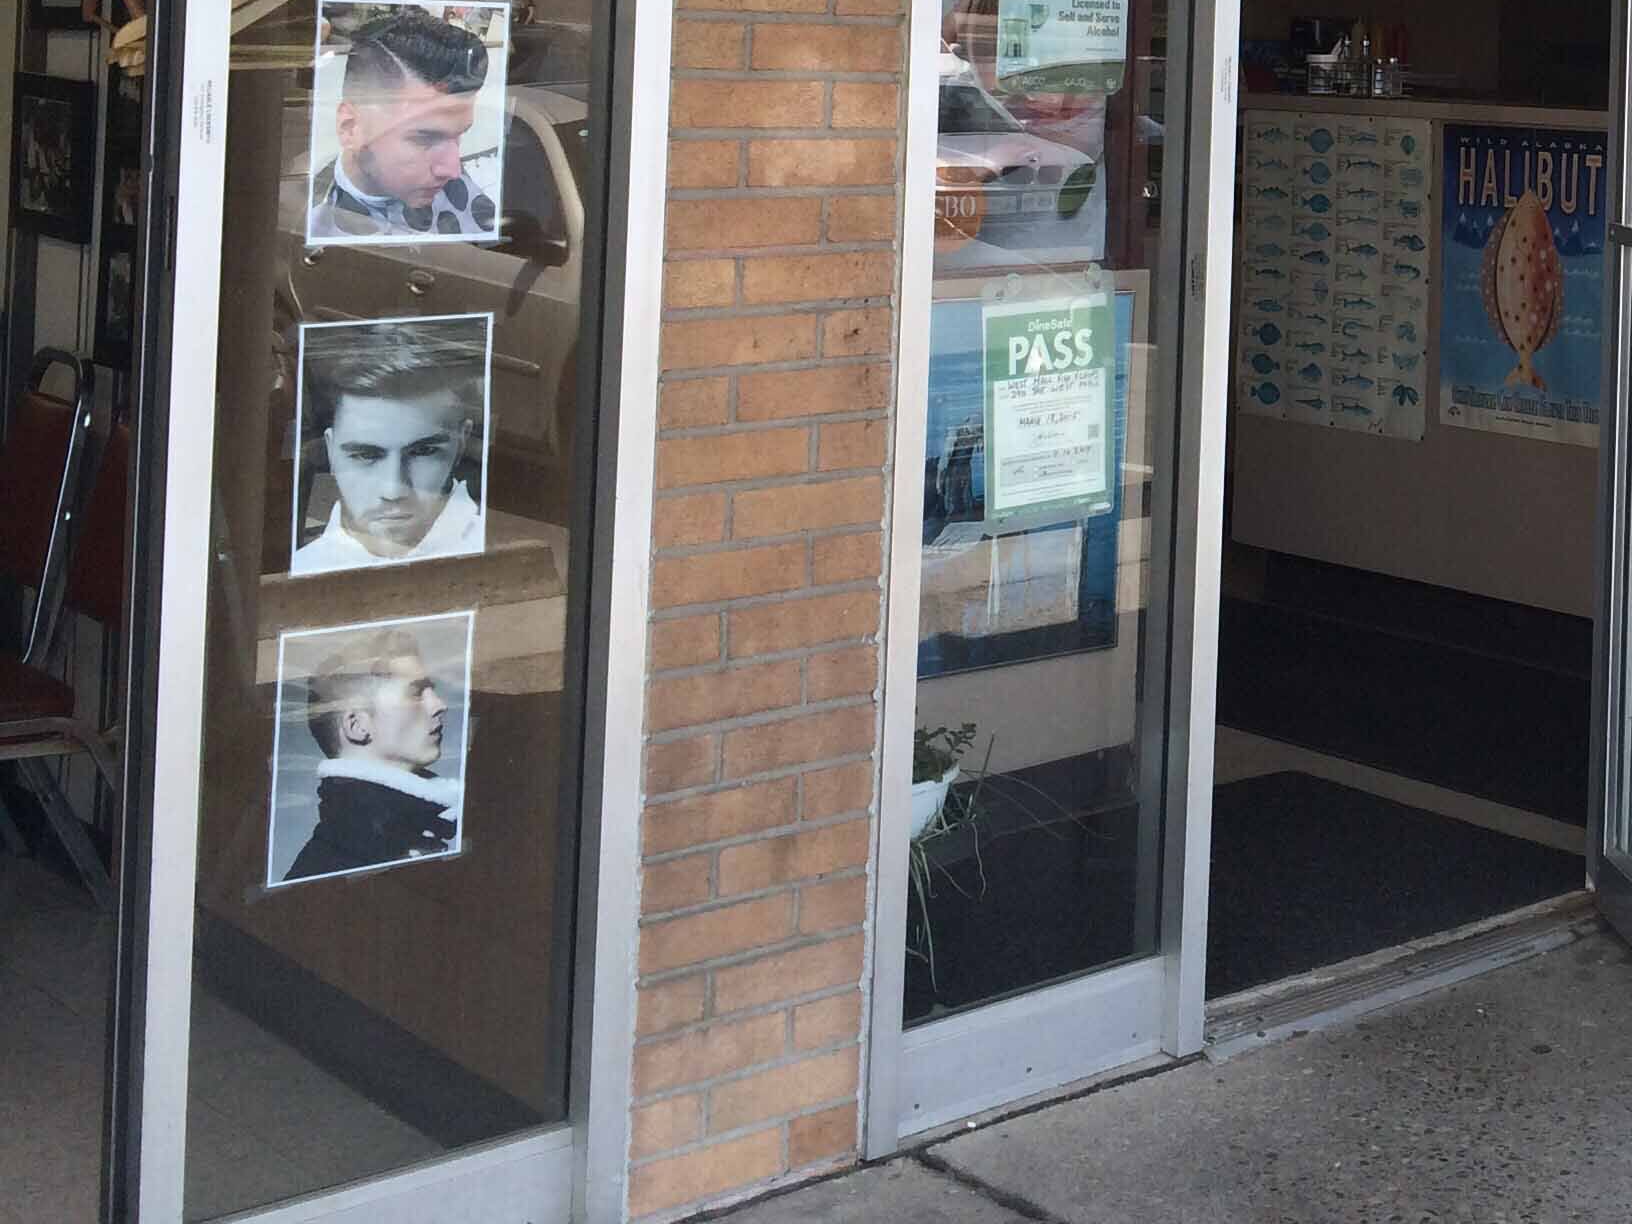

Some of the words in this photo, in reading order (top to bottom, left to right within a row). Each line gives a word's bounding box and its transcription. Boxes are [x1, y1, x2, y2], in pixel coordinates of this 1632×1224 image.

[1459, 136, 1509, 146] WILD
[1458, 146, 1603, 216] HALIBUT
[1008, 327, 1094, 376] PASS
